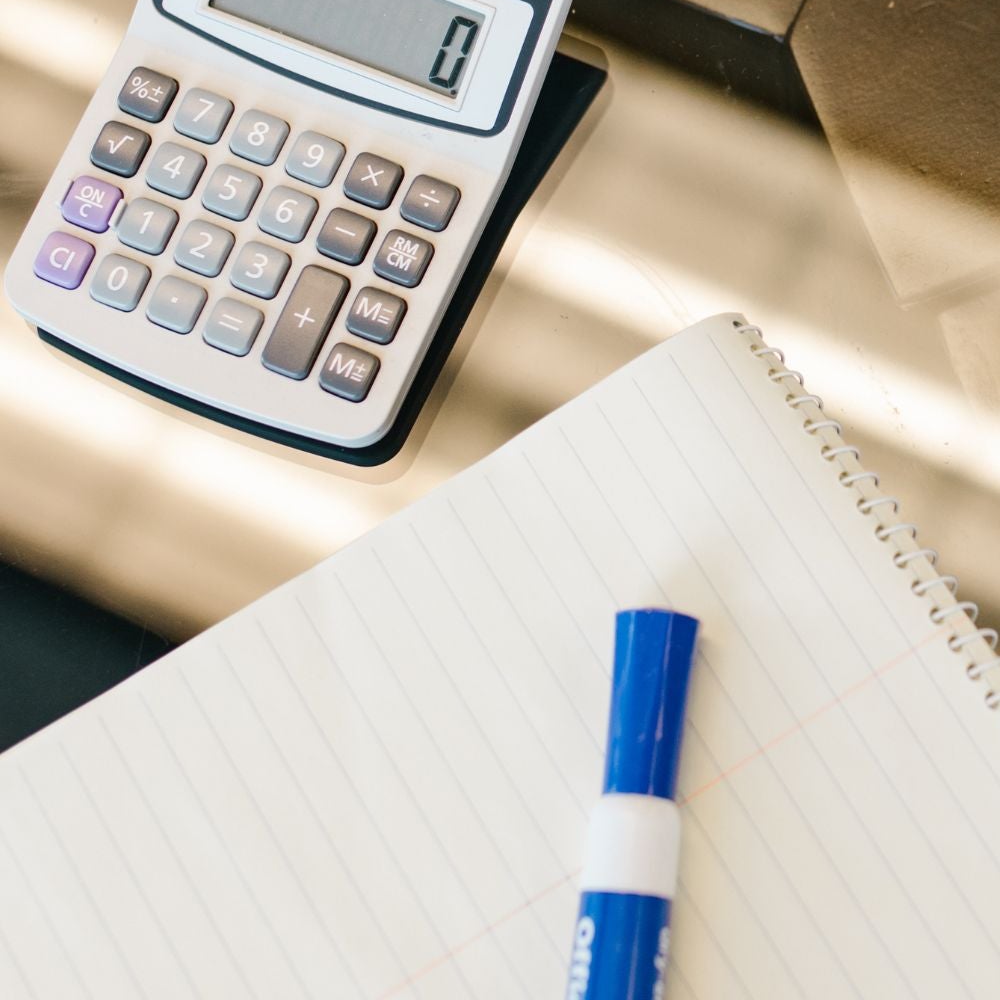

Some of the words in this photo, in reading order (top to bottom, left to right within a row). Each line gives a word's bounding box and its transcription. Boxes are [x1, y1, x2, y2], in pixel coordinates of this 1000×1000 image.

[189, 98, 214, 124] 7
[247, 122, 270, 147] 8
[163, 154, 187, 180] 4
[302, 143, 325, 169] 9
[80, 185, 106, 203] ON
[218, 176, 243, 201] 5
[79, 203, 92, 218] C
[137, 211, 154, 235] 1
[275, 199, 298, 224] 6
[189, 232, 214, 259] 2
[393, 236, 420, 256] RM
[244, 253, 268, 280] 3
[386, 252, 412, 271] CM
[107, 266, 129, 292] 0
